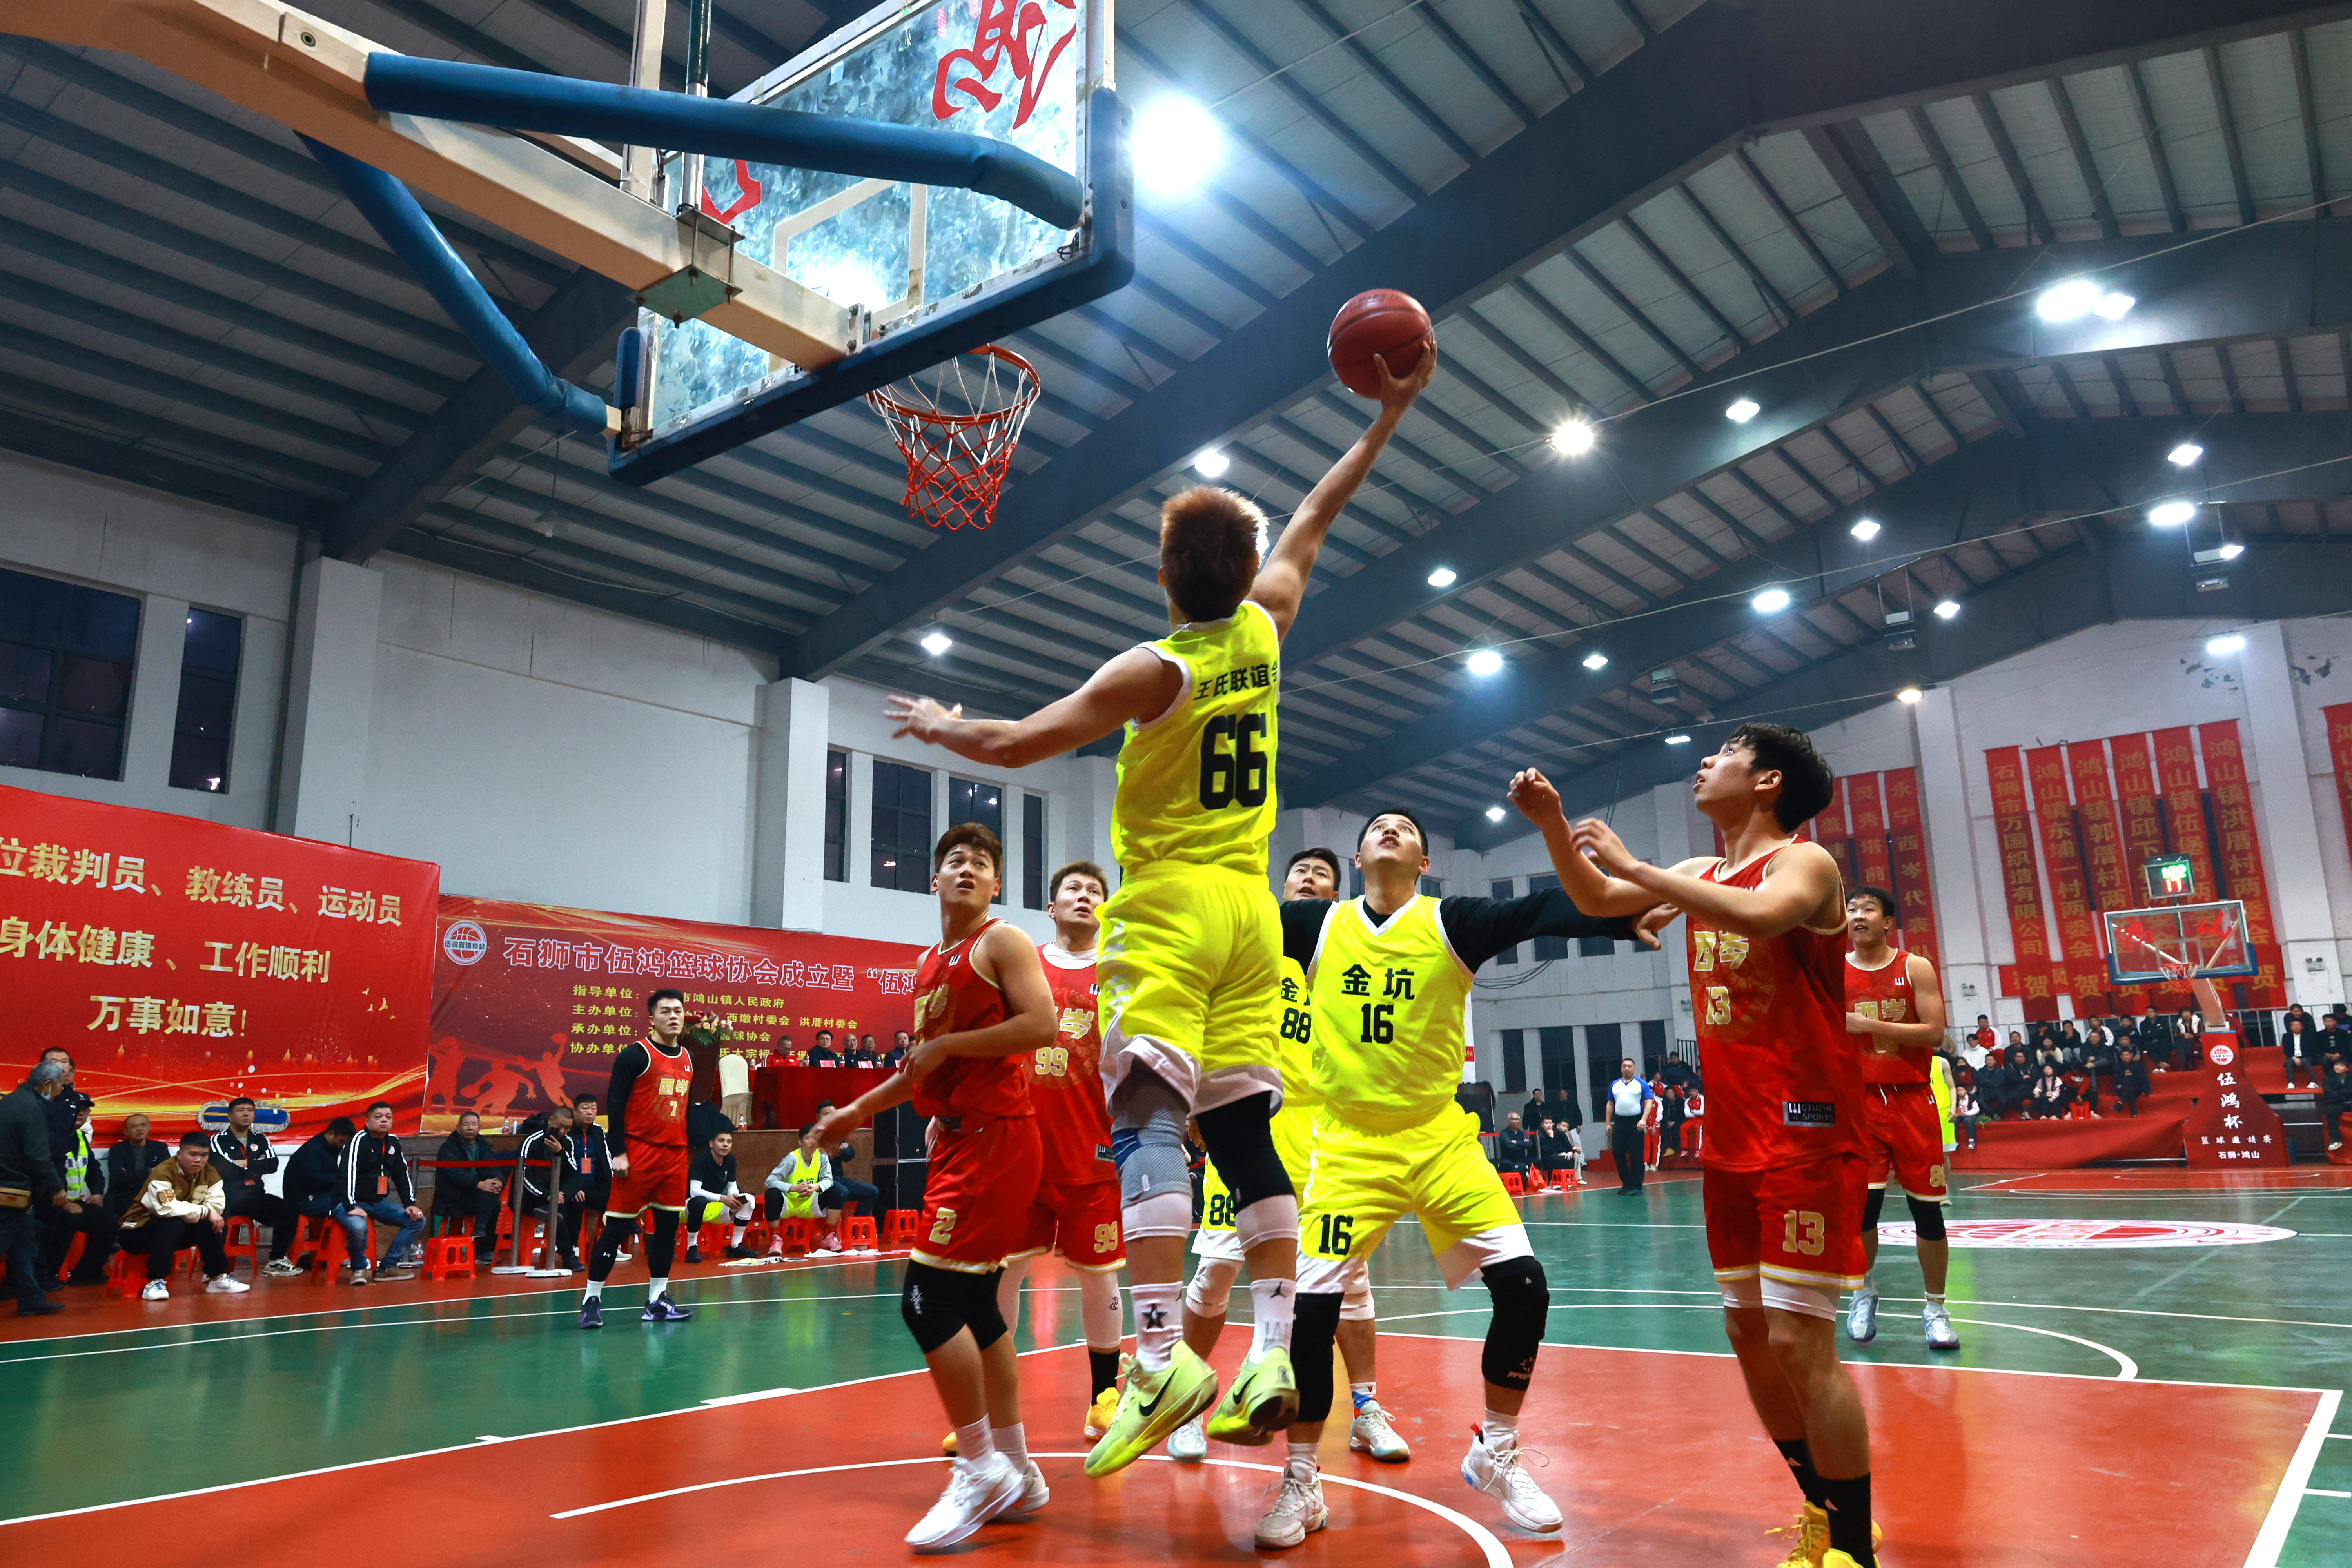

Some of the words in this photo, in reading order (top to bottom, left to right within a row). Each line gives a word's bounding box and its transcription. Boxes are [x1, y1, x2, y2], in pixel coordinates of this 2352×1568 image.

[1200, 712, 1268, 810] 66
[1341, 964, 1415, 1000] 金坑
[2024, 975, 2051, 1000] 贺
[2074, 975, 2102, 999] 贺
[1360, 1003, 1394, 1044] 16
[1706, 986, 1731, 1025] 13
[1279, 1007, 1312, 1044] 88
[1035, 1046, 1069, 1077] 99
[658, 1078, 689, 1096] 西岑
[670, 1100, 678, 1116] 7
[928, 1207, 958, 1245] 2
[1094, 1220, 1118, 1253] 99
[1319, 1214, 1354, 1255] 16
[1783, 1209, 1825, 1256] 13
